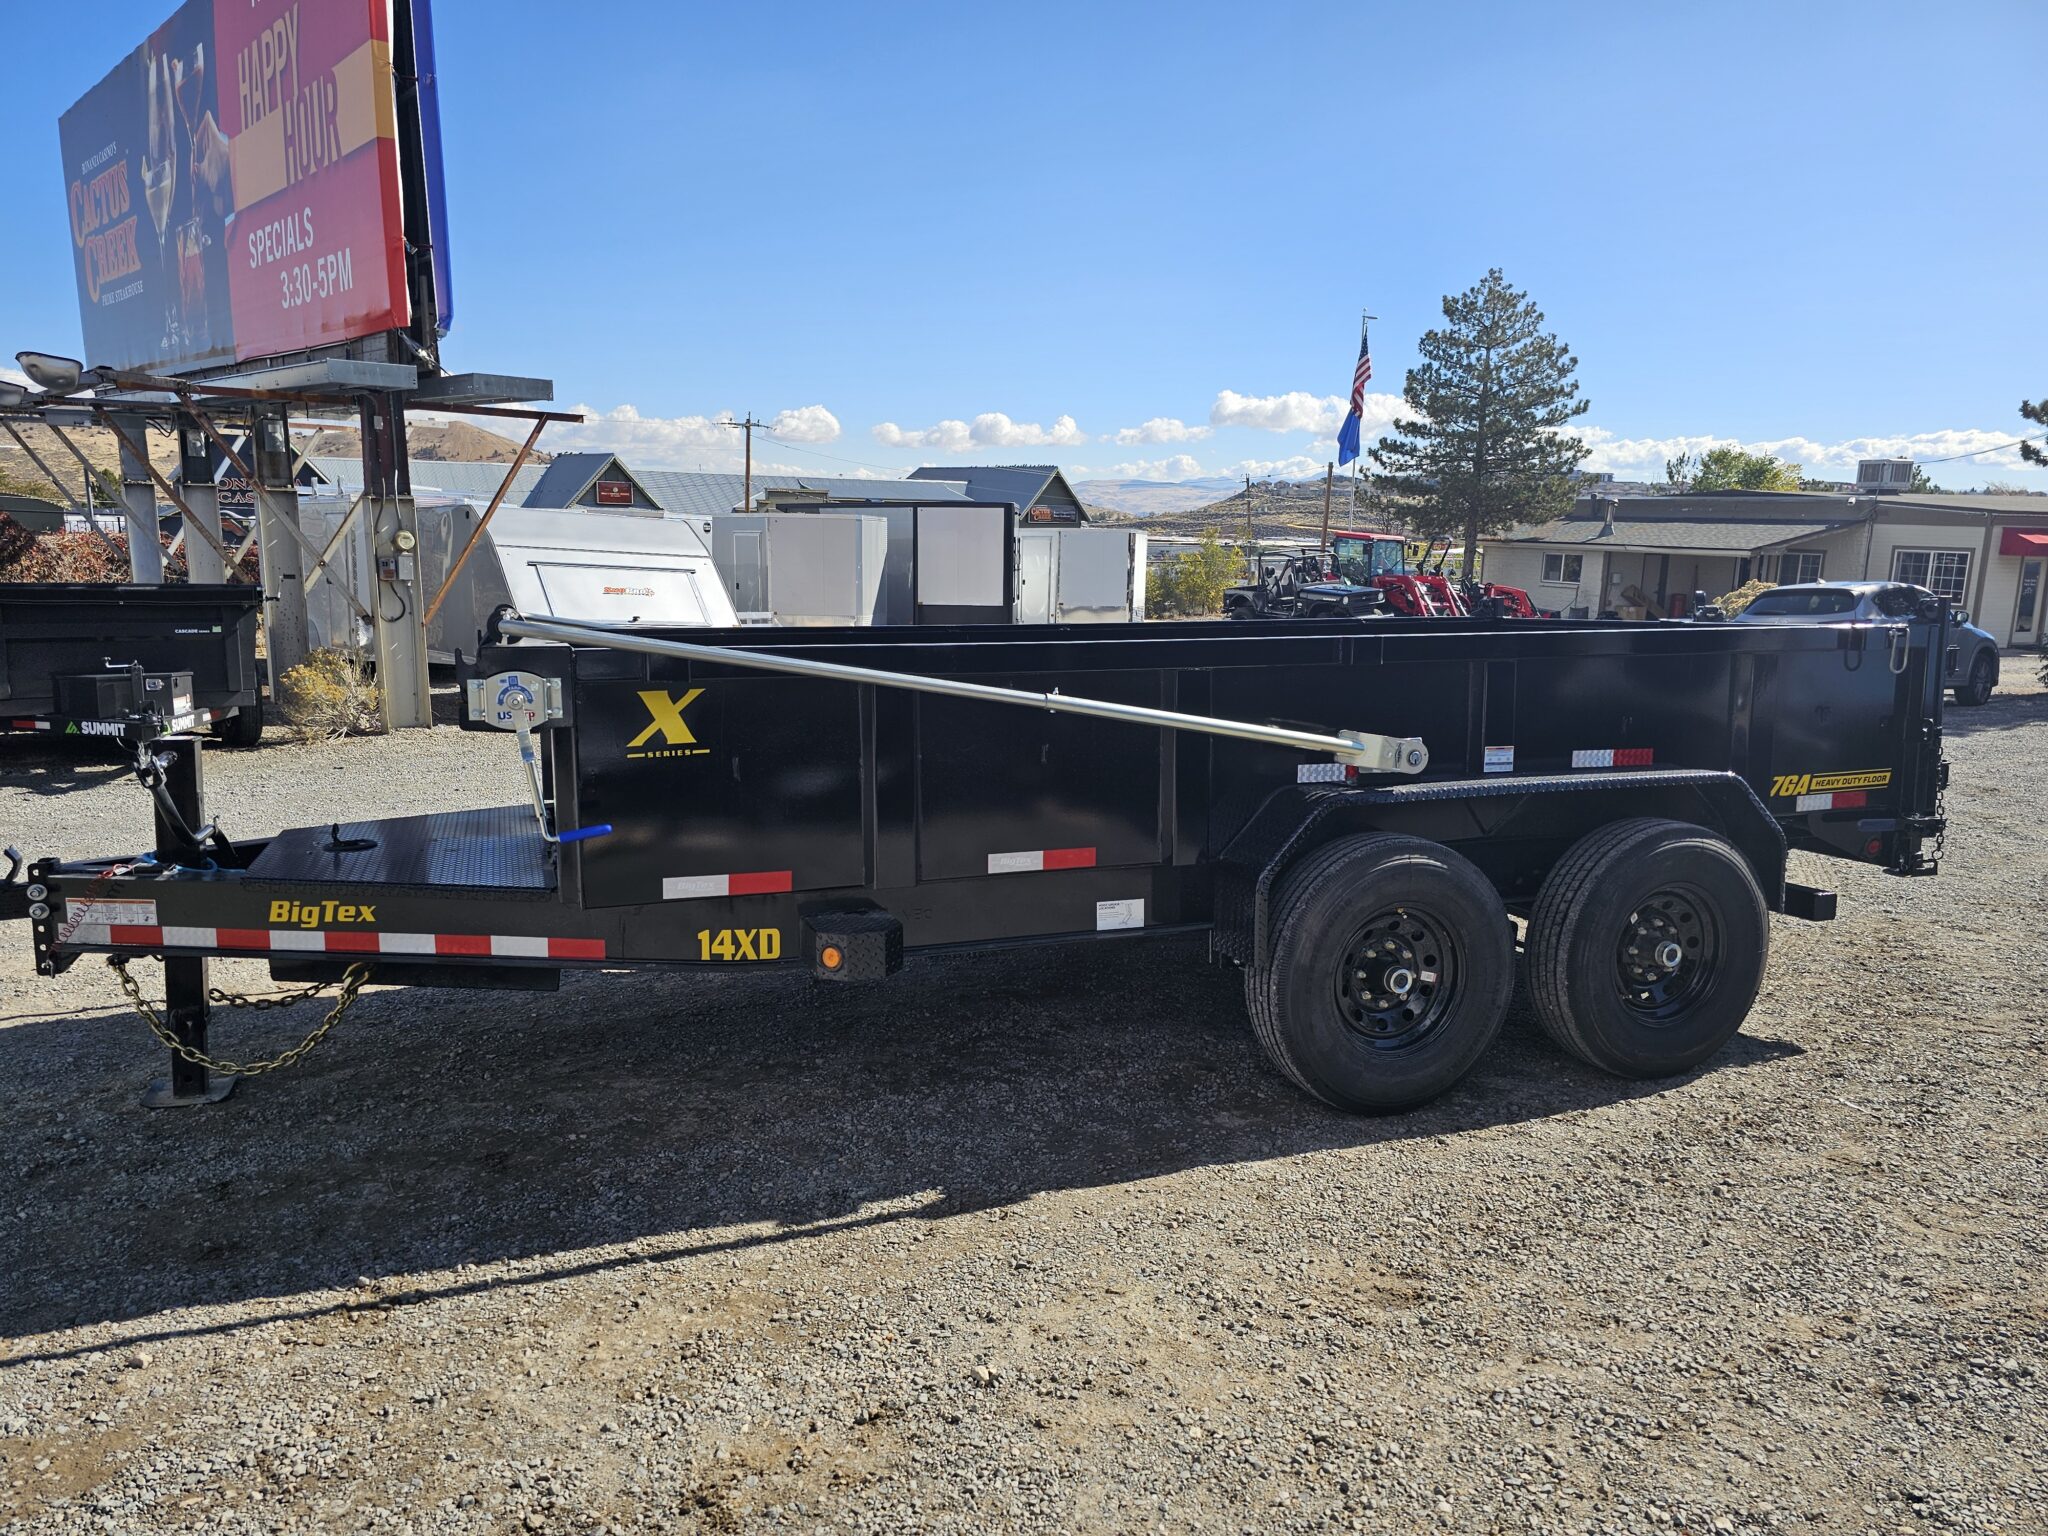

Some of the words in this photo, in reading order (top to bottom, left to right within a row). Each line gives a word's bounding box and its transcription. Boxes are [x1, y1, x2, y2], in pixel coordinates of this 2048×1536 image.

[238, 2, 299, 132] HAPPY
[282, 68, 342, 187] HOUR
[70, 159, 130, 249] CACTUS
[84, 215, 142, 304] CREEK
[248, 206, 314, 269] SPECIALS
[280, 247, 353, 309] 3:30-5PM
[81, 721, 126, 737] SUMMIT
[171, 714, 195, 732] SUMMIT
[497, 711, 512, 720] US
[626, 688, 706, 747] X
[647, 749, 691, 758] SERIES
[1769, 774, 1811, 797] 7GA
[1815, 778, 1841, 788] HEAVY
[1841, 776, 1863, 786] DUTY
[1862, 774, 1888, 784] FLOOR
[269, 900, 377, 928] BigTex
[697, 928, 781, 961] 14XD
